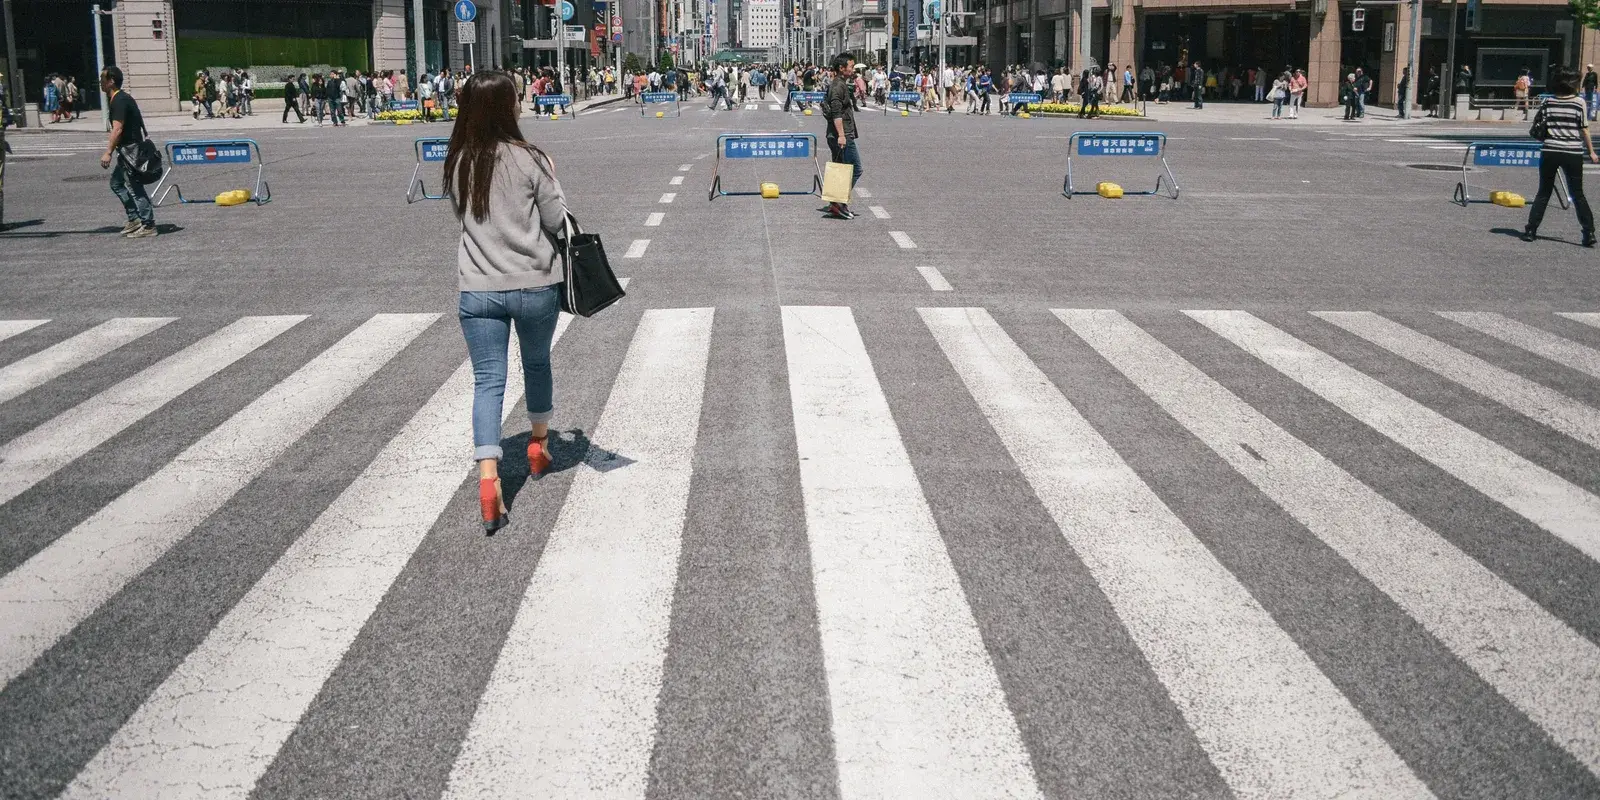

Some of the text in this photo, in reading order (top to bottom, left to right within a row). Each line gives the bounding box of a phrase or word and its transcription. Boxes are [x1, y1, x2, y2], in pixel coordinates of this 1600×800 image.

[731, 141, 804, 149] 歩行者天国実施中
